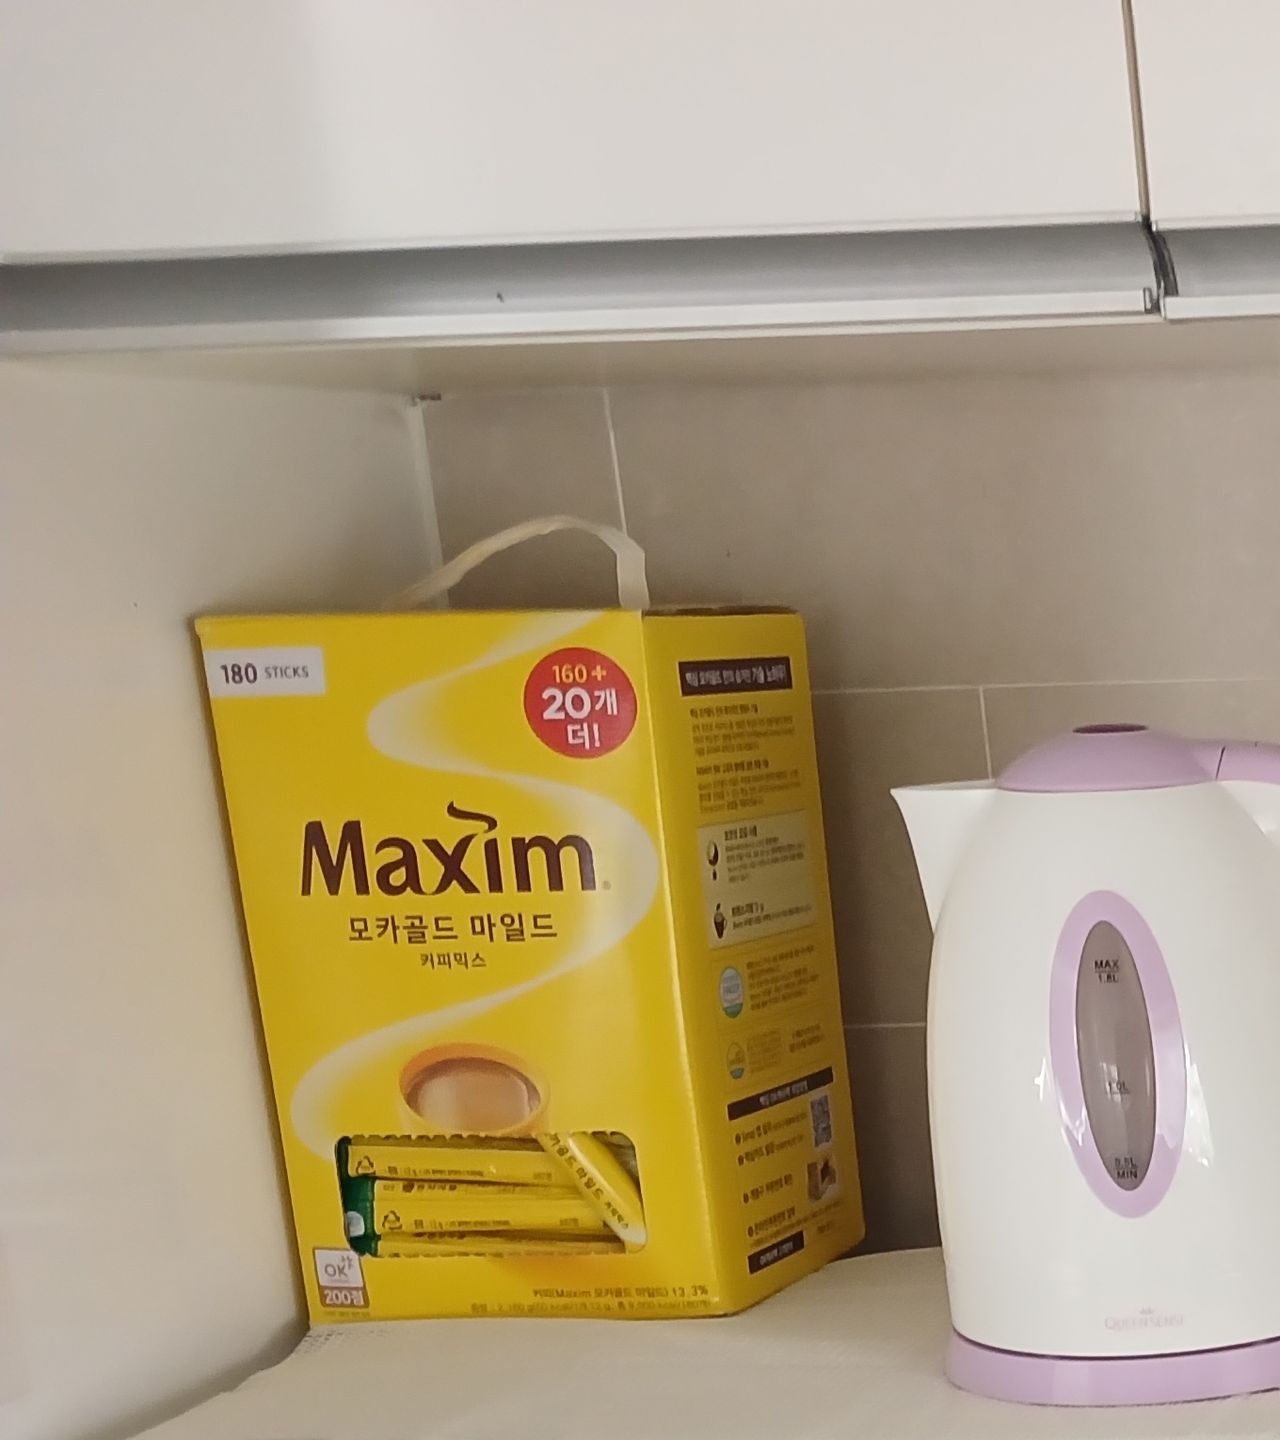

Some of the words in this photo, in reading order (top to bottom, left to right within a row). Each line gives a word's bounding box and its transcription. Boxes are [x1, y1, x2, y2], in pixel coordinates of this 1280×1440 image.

[220, 662, 258, 685] 180
[264, 664, 310, 679] STICKS
[541, 686, 618, 720] 20개
[566, 721, 601, 750] 더!
[300, 800, 597, 897] Maxim
[348, 913, 459, 944] 모카골드
[470, 912, 558, 943] 마일드
[420, 951, 488, 970] 커피믹스
[1094, 959, 1120, 970] MAX
[1097, 973, 1119, 983] 1.8L
[1116, 1168, 1139, 1180] MIN
[324, 1263, 349, 1279] OK
